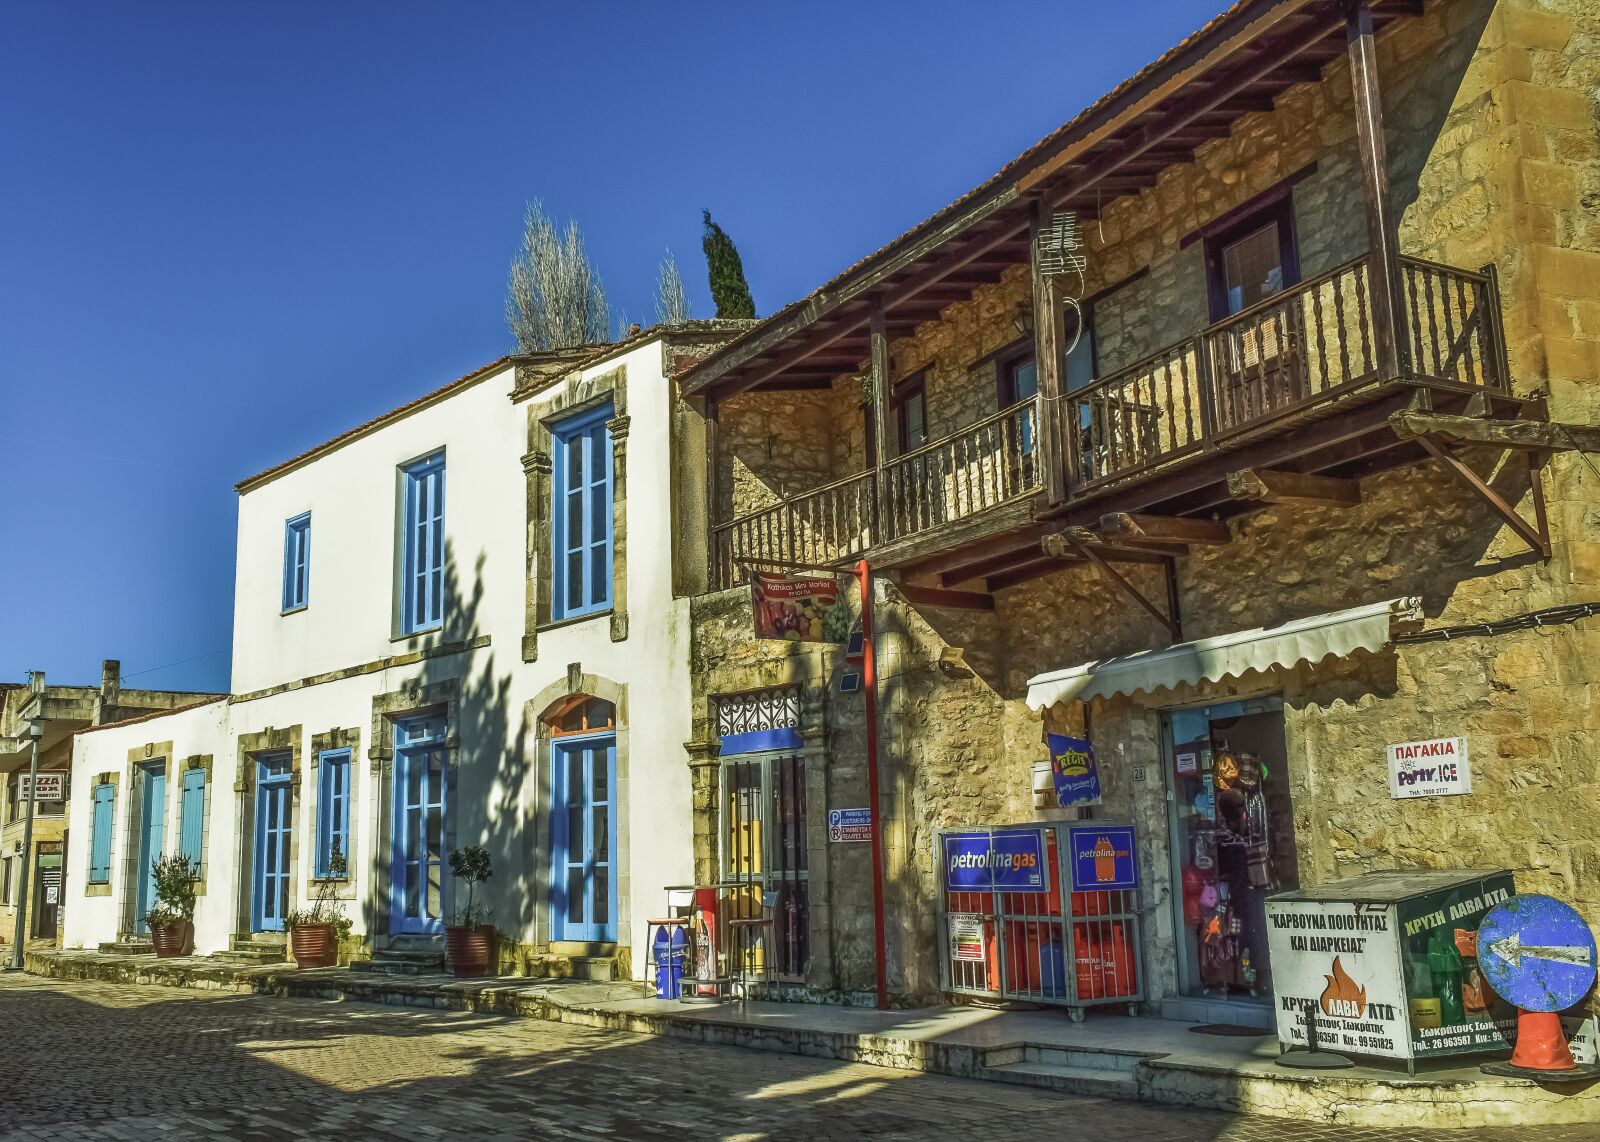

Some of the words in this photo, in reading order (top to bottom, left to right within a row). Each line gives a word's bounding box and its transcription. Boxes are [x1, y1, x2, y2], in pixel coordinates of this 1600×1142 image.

[808, 581, 830, 589] Market
[1395, 742, 1454, 760] ΠΑΓΑΚΙΑ
[1061, 755, 1086, 769] REGIS
[1134, 768, 1144, 779] 28
[950, 850, 1036, 872] petrolinagas
[1080, 848, 1128, 859] petrolinagas
[1328, 914, 1388, 931] ΠΟΙΟΤΗΤΑΣ
[1404, 910, 1446, 936] ΧΡΥΣΗ
[1449, 896, 1484, 920] ΛΑΒΑ
[1290, 936, 1308, 951] ΚΑΙ
[1328, 998, 1360, 1017] ΛΑΒΑ
[1368, 1003, 1394, 1021] ΛΤΔ
[1342, 1020, 1385, 1034] Σωκράτης
[1420, 1023, 1473, 1038] Σωκράτους
[1358, 1036, 1368, 1047] 99
[1369, 1037, 1394, 1050] 551825
[1432, 1039, 1442, 1049] 26
[1444, 1035, 1471, 1048] 963587
[1492, 1031, 1502, 1041] 99
